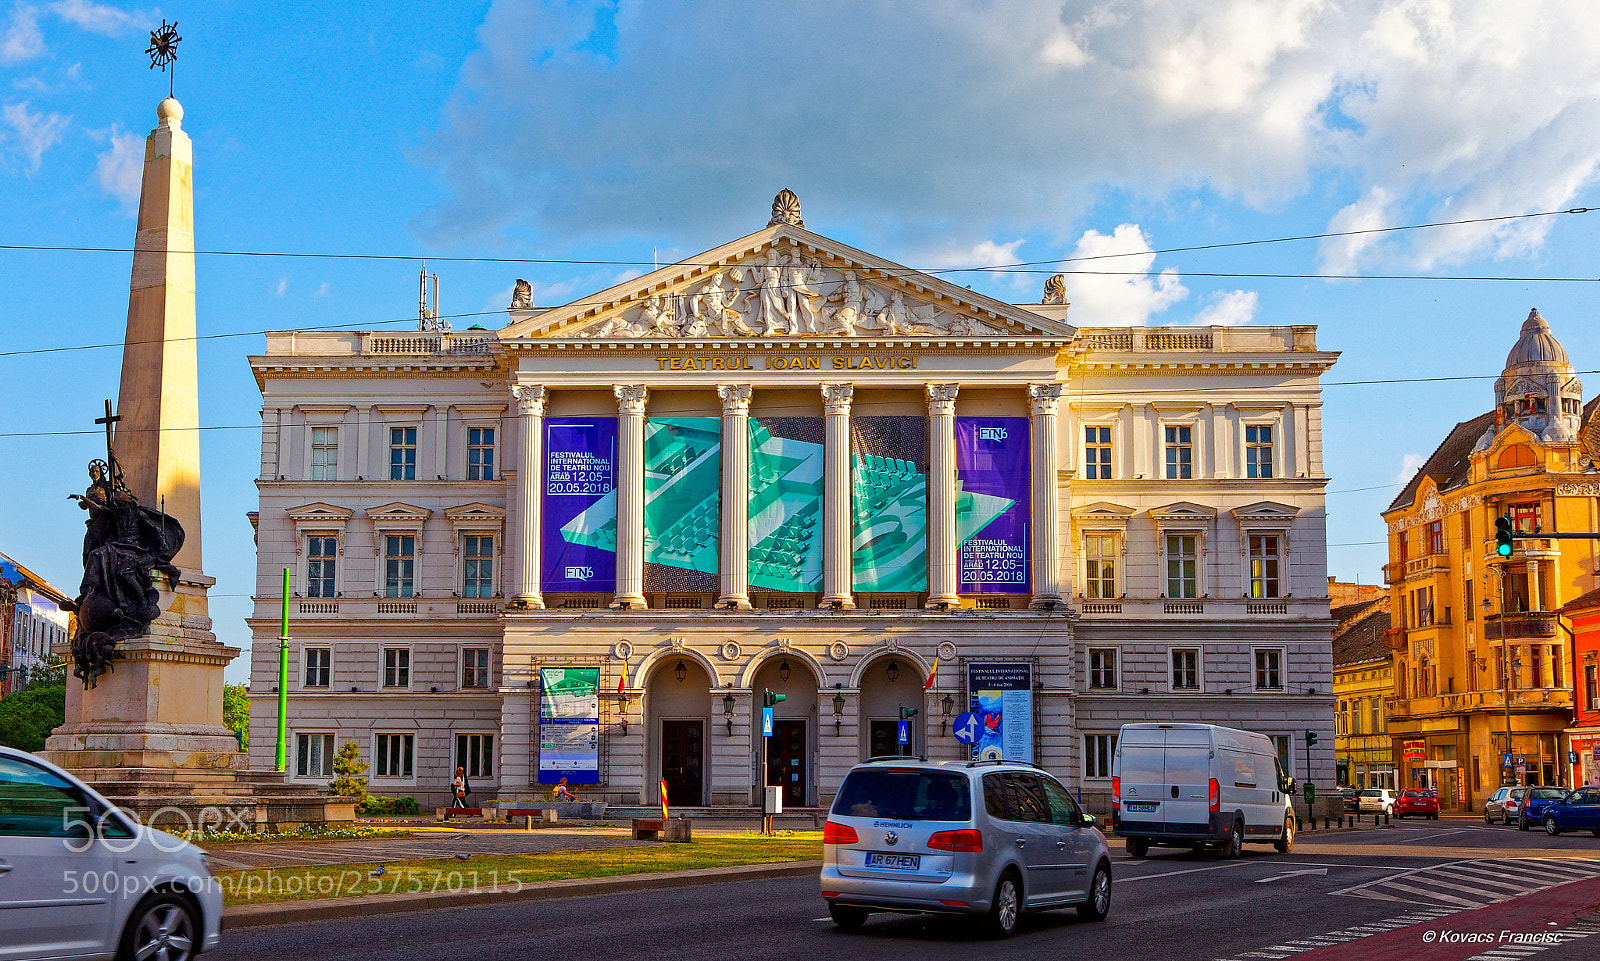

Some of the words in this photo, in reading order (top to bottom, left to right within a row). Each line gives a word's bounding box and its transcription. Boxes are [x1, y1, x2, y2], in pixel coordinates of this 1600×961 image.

[655, 356, 754, 370] TEATRUL
[765, 356, 821, 370] IOAN
[832, 356, 918, 370] SLAVICI
[550, 451, 595, 459] FESTIVALUL
[549, 482, 610, 493] 20.05.2018
[963, 571, 1023, 581] 20.05.2018
[880, 821, 913, 829] HENNLICH
[871, 855, 883, 865] AR
[885, 856, 897, 866] 67
[897, 856, 918, 867] HEN
